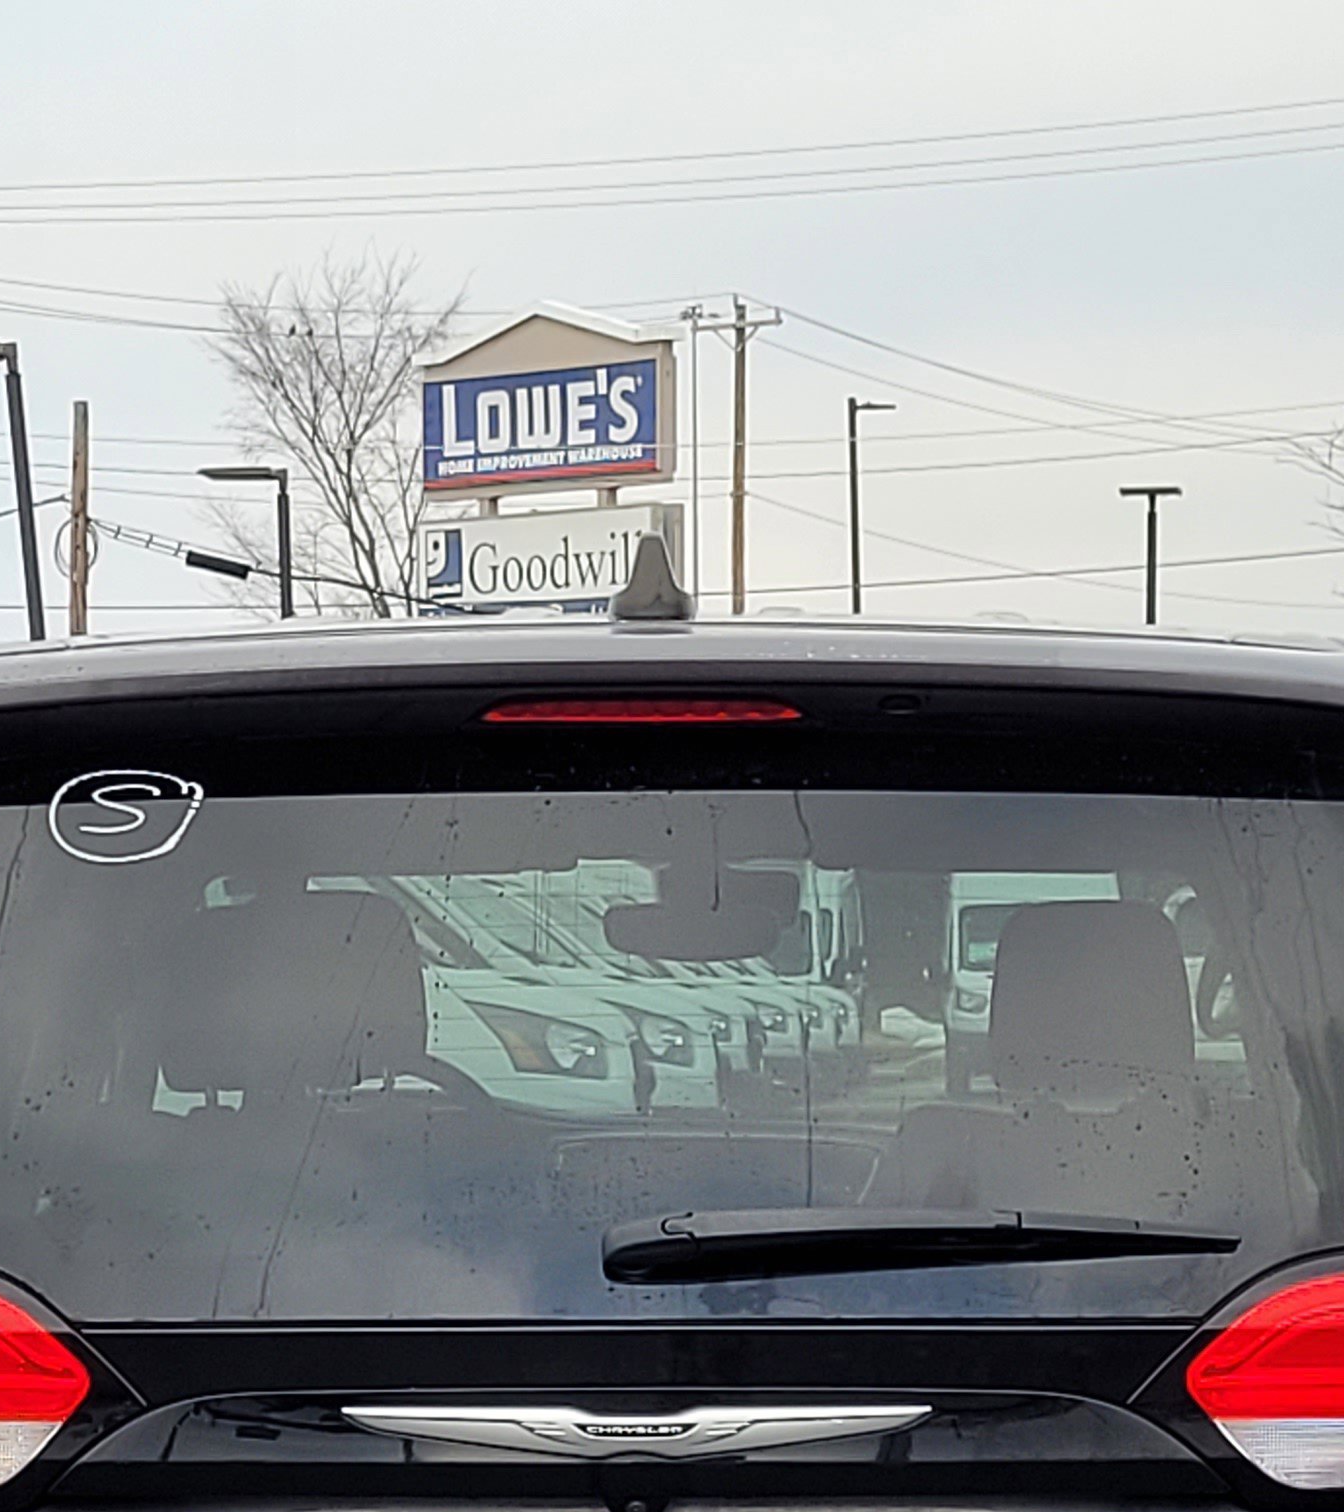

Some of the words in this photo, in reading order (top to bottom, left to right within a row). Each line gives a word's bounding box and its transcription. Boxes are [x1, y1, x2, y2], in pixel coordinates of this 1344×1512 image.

[442, 368, 639, 457] LOWE'S
[438, 458, 474, 476] HOME
[477, 450, 565, 472] IMPROVEMENT
[567, 444, 643, 464] WAREHOUSE
[469, 530, 642, 594] Goodwil
[586, 1425, 683, 1435] CHRYSLER
